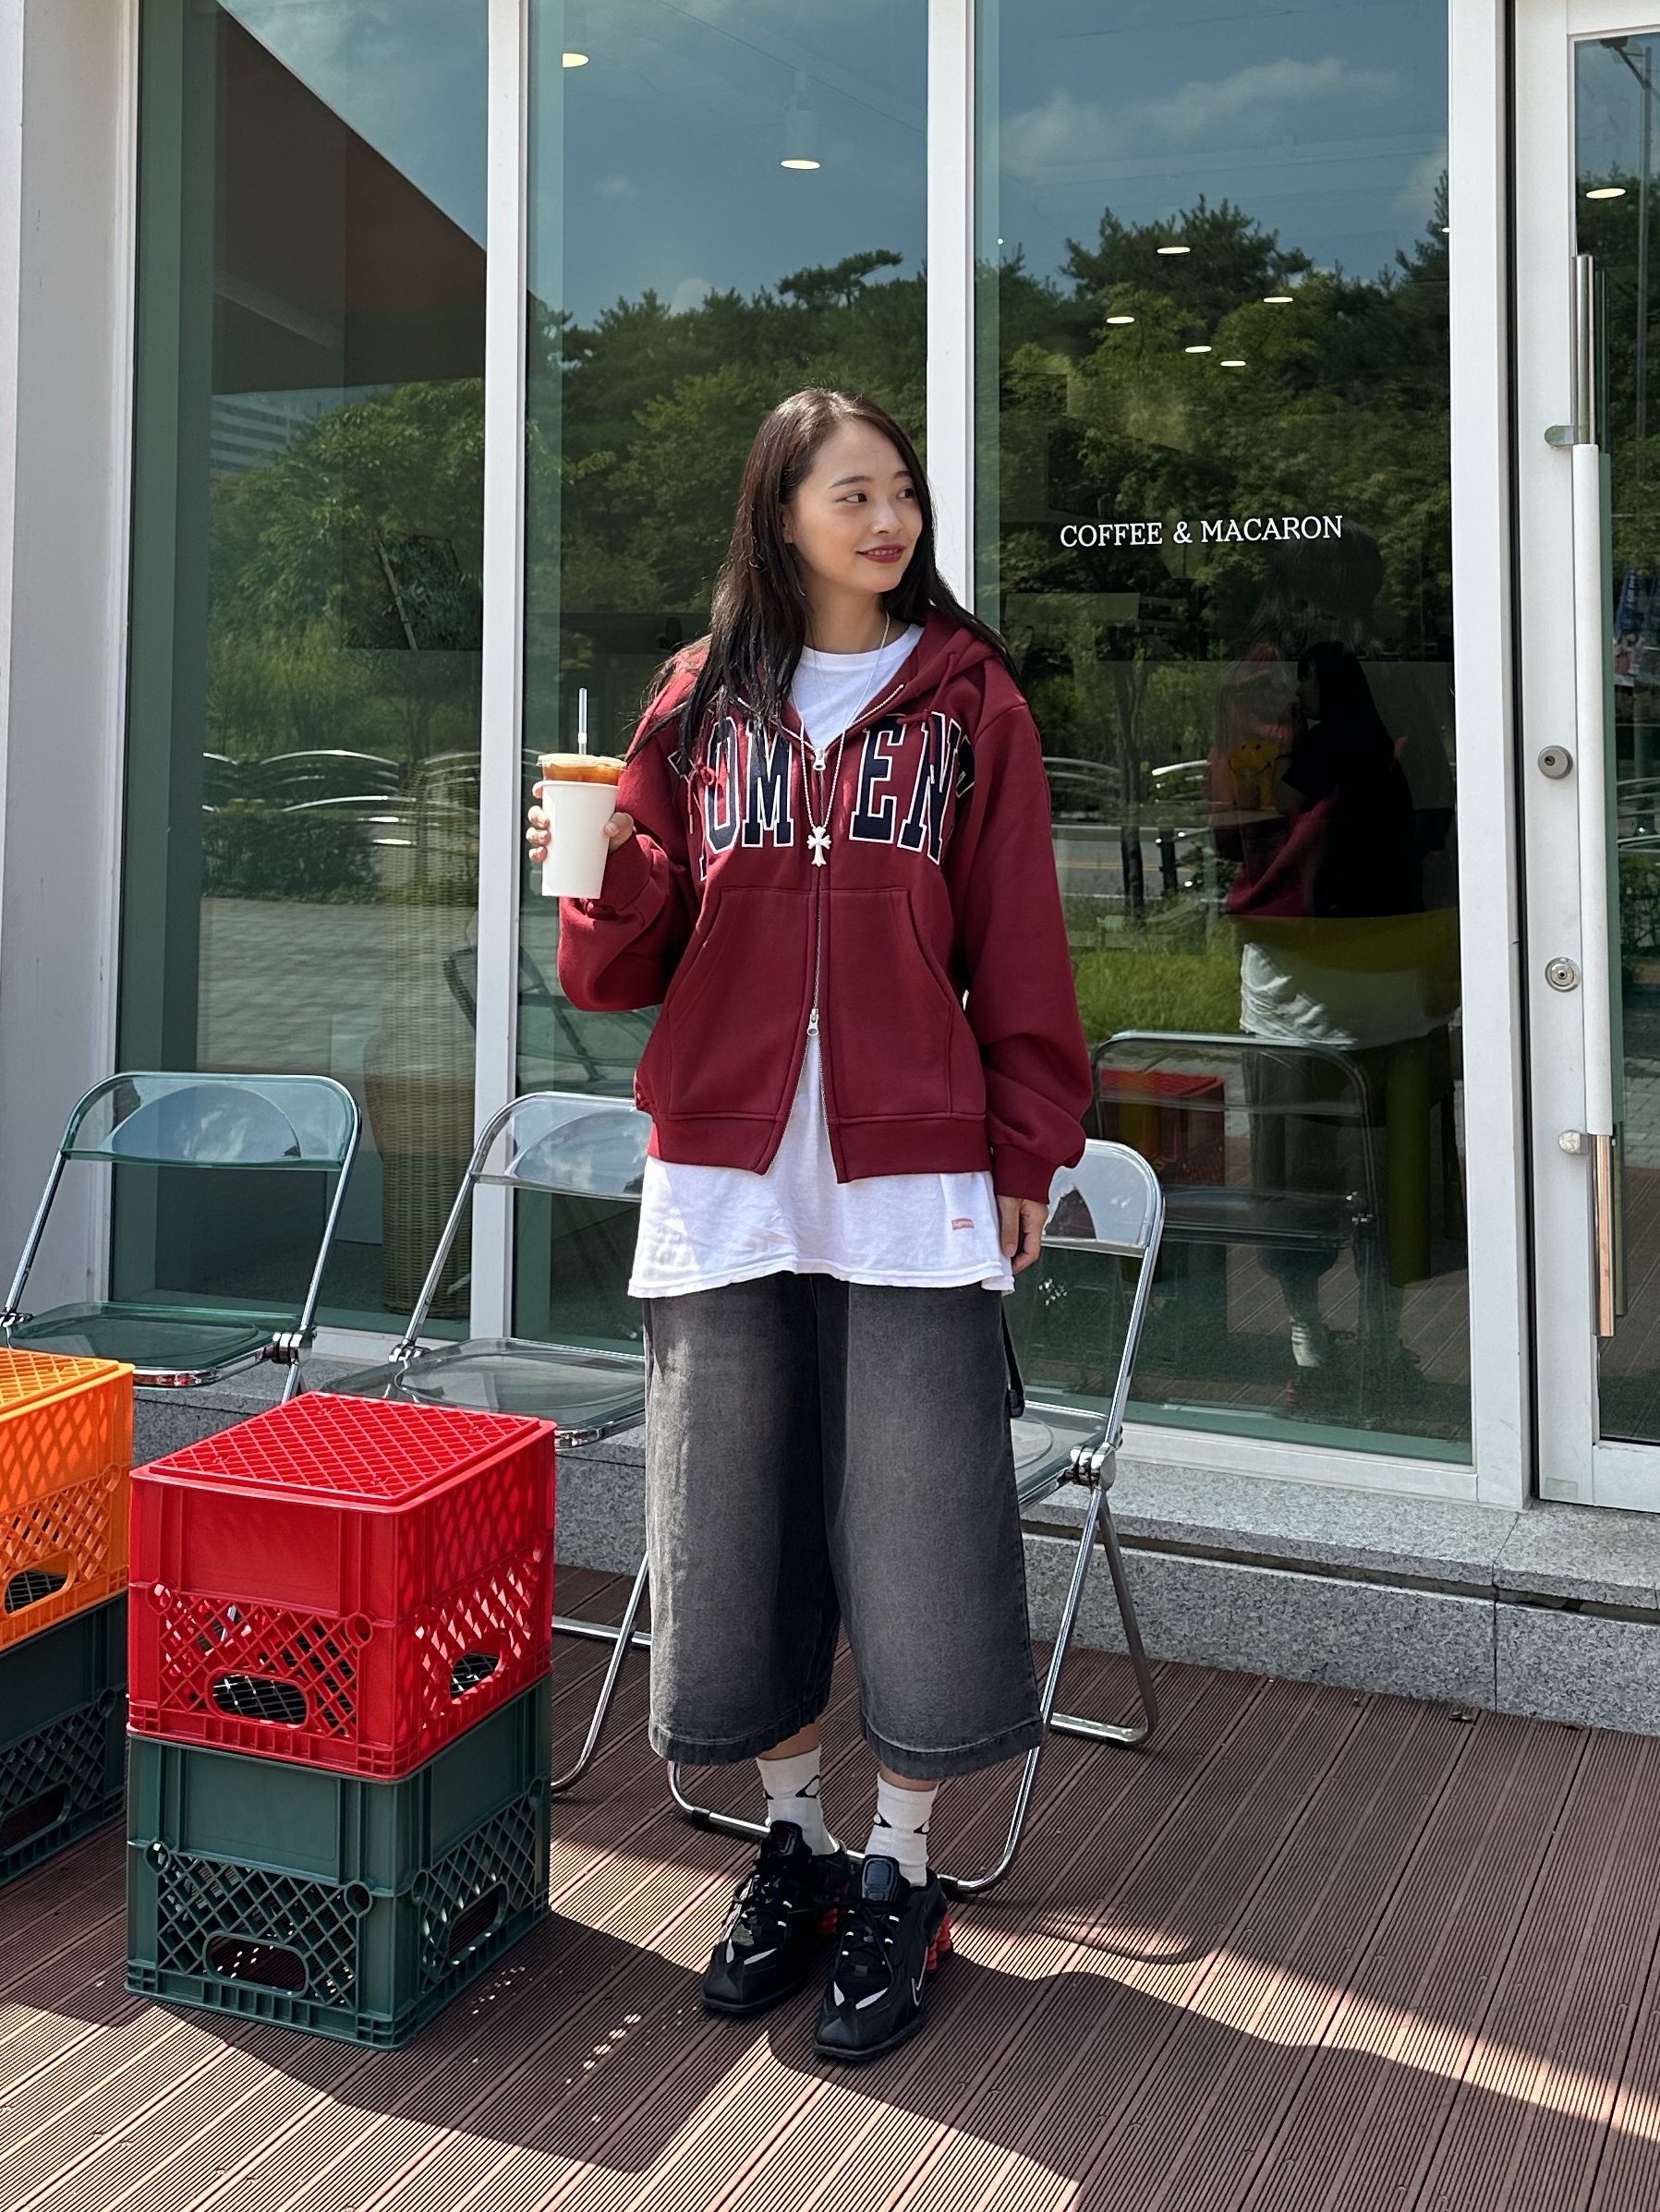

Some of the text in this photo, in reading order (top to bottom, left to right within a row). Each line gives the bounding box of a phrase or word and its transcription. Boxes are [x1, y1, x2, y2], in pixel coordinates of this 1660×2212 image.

[1060, 515, 1343, 548] COFFEE & MACARON
